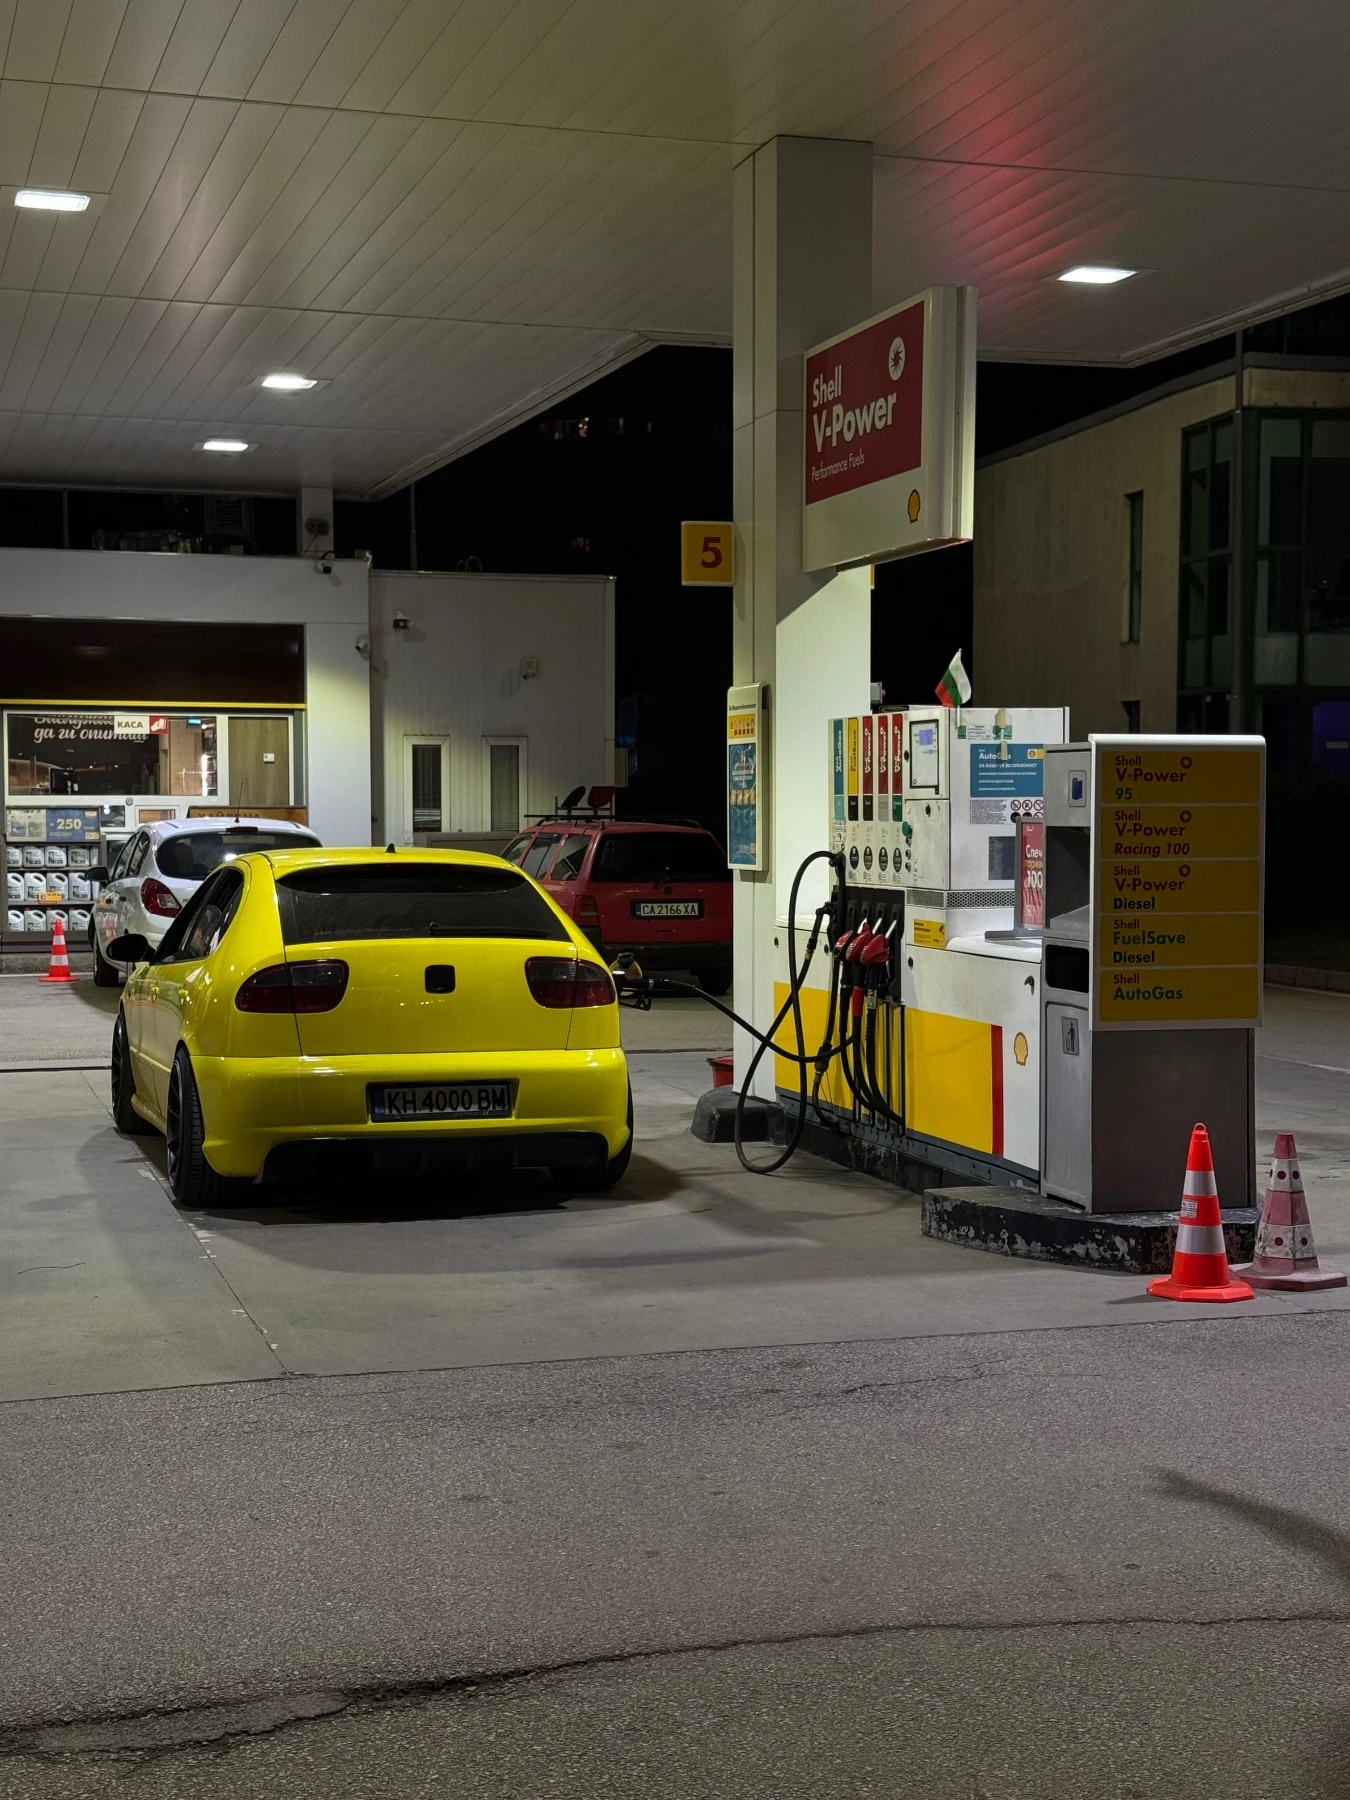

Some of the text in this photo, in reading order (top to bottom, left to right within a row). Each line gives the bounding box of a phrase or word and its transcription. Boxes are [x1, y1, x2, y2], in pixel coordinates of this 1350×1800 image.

[812, 364, 842, 408] Shell
[812, 392, 897, 453] V-Power
[811, 448, 865, 483] Performance Fuels
[700, 536, 723, 569] 5
[1115, 755, 1142, 766] Shell
[1116, 767, 1187, 782] V-Power
[1115, 788, 1132, 800] 95
[1114, 810, 1141, 821] Shell
[56, 818, 82, 830] 250
[1115, 822, 1187, 837] V-Power
[1114, 842, 1190, 858] Racing 100
[1114, 865, 1140, 876] Shell
[1114, 877, 1186, 892] V-Power
[642, 904, 697, 915] CA 2166 XA
[1114, 896, 1156, 910] Diesel
[1114, 918, 1140, 930] Shell
[1114, 930, 1186, 945] FuelSave
[1114, 950, 1155, 964] Diesel
[1114, 973, 1140, 984] Shell
[1114, 986, 1184, 1000] AutoGas
[387, 1088, 506, 1114] KH 4000 BM
